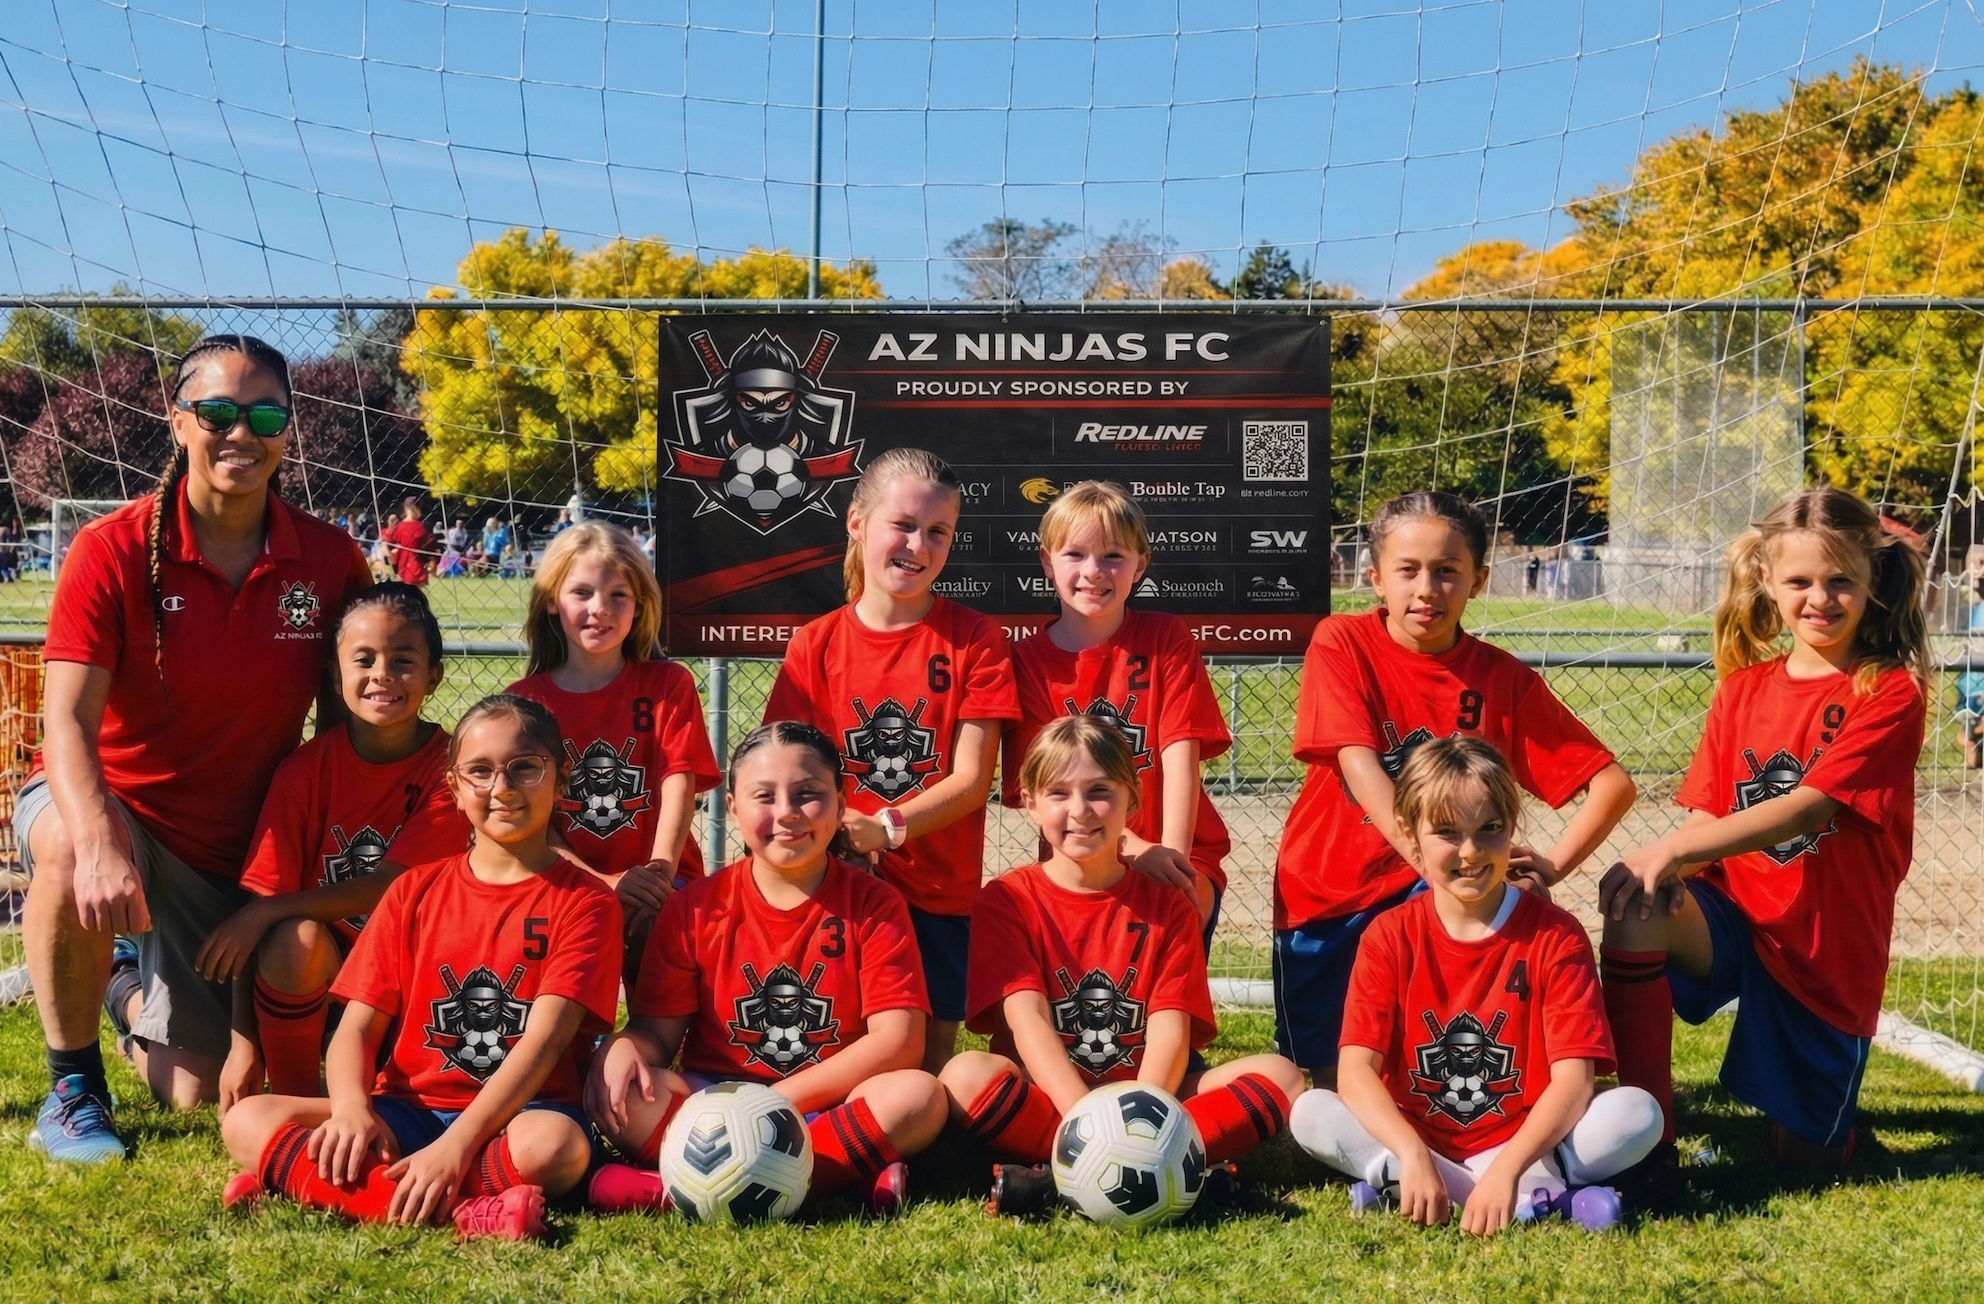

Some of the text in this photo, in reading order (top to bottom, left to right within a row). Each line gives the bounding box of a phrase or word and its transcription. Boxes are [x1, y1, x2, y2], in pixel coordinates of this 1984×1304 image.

[867, 332, 1230, 362] AZ NINJAS FC
[896, 381, 1190, 396] PROUDLY SPONSORED BY
[1074, 422, 1208, 443] REDLINE
[1194, 482, 1226, 499] Tap
[1250, 531, 1308, 547] SW
[929, 577, 992, 596] enality
[928, 653, 952, 694] 6
[1126, 654, 1151, 691] 2
[633, 696, 655, 733] 8
[1457, 689, 1484, 730] 9
[522, 917, 549, 961] 5
[820, 916, 846, 958] 3
[1127, 922, 1150, 964] 7
[1504, 959, 1531, 1002] 4
